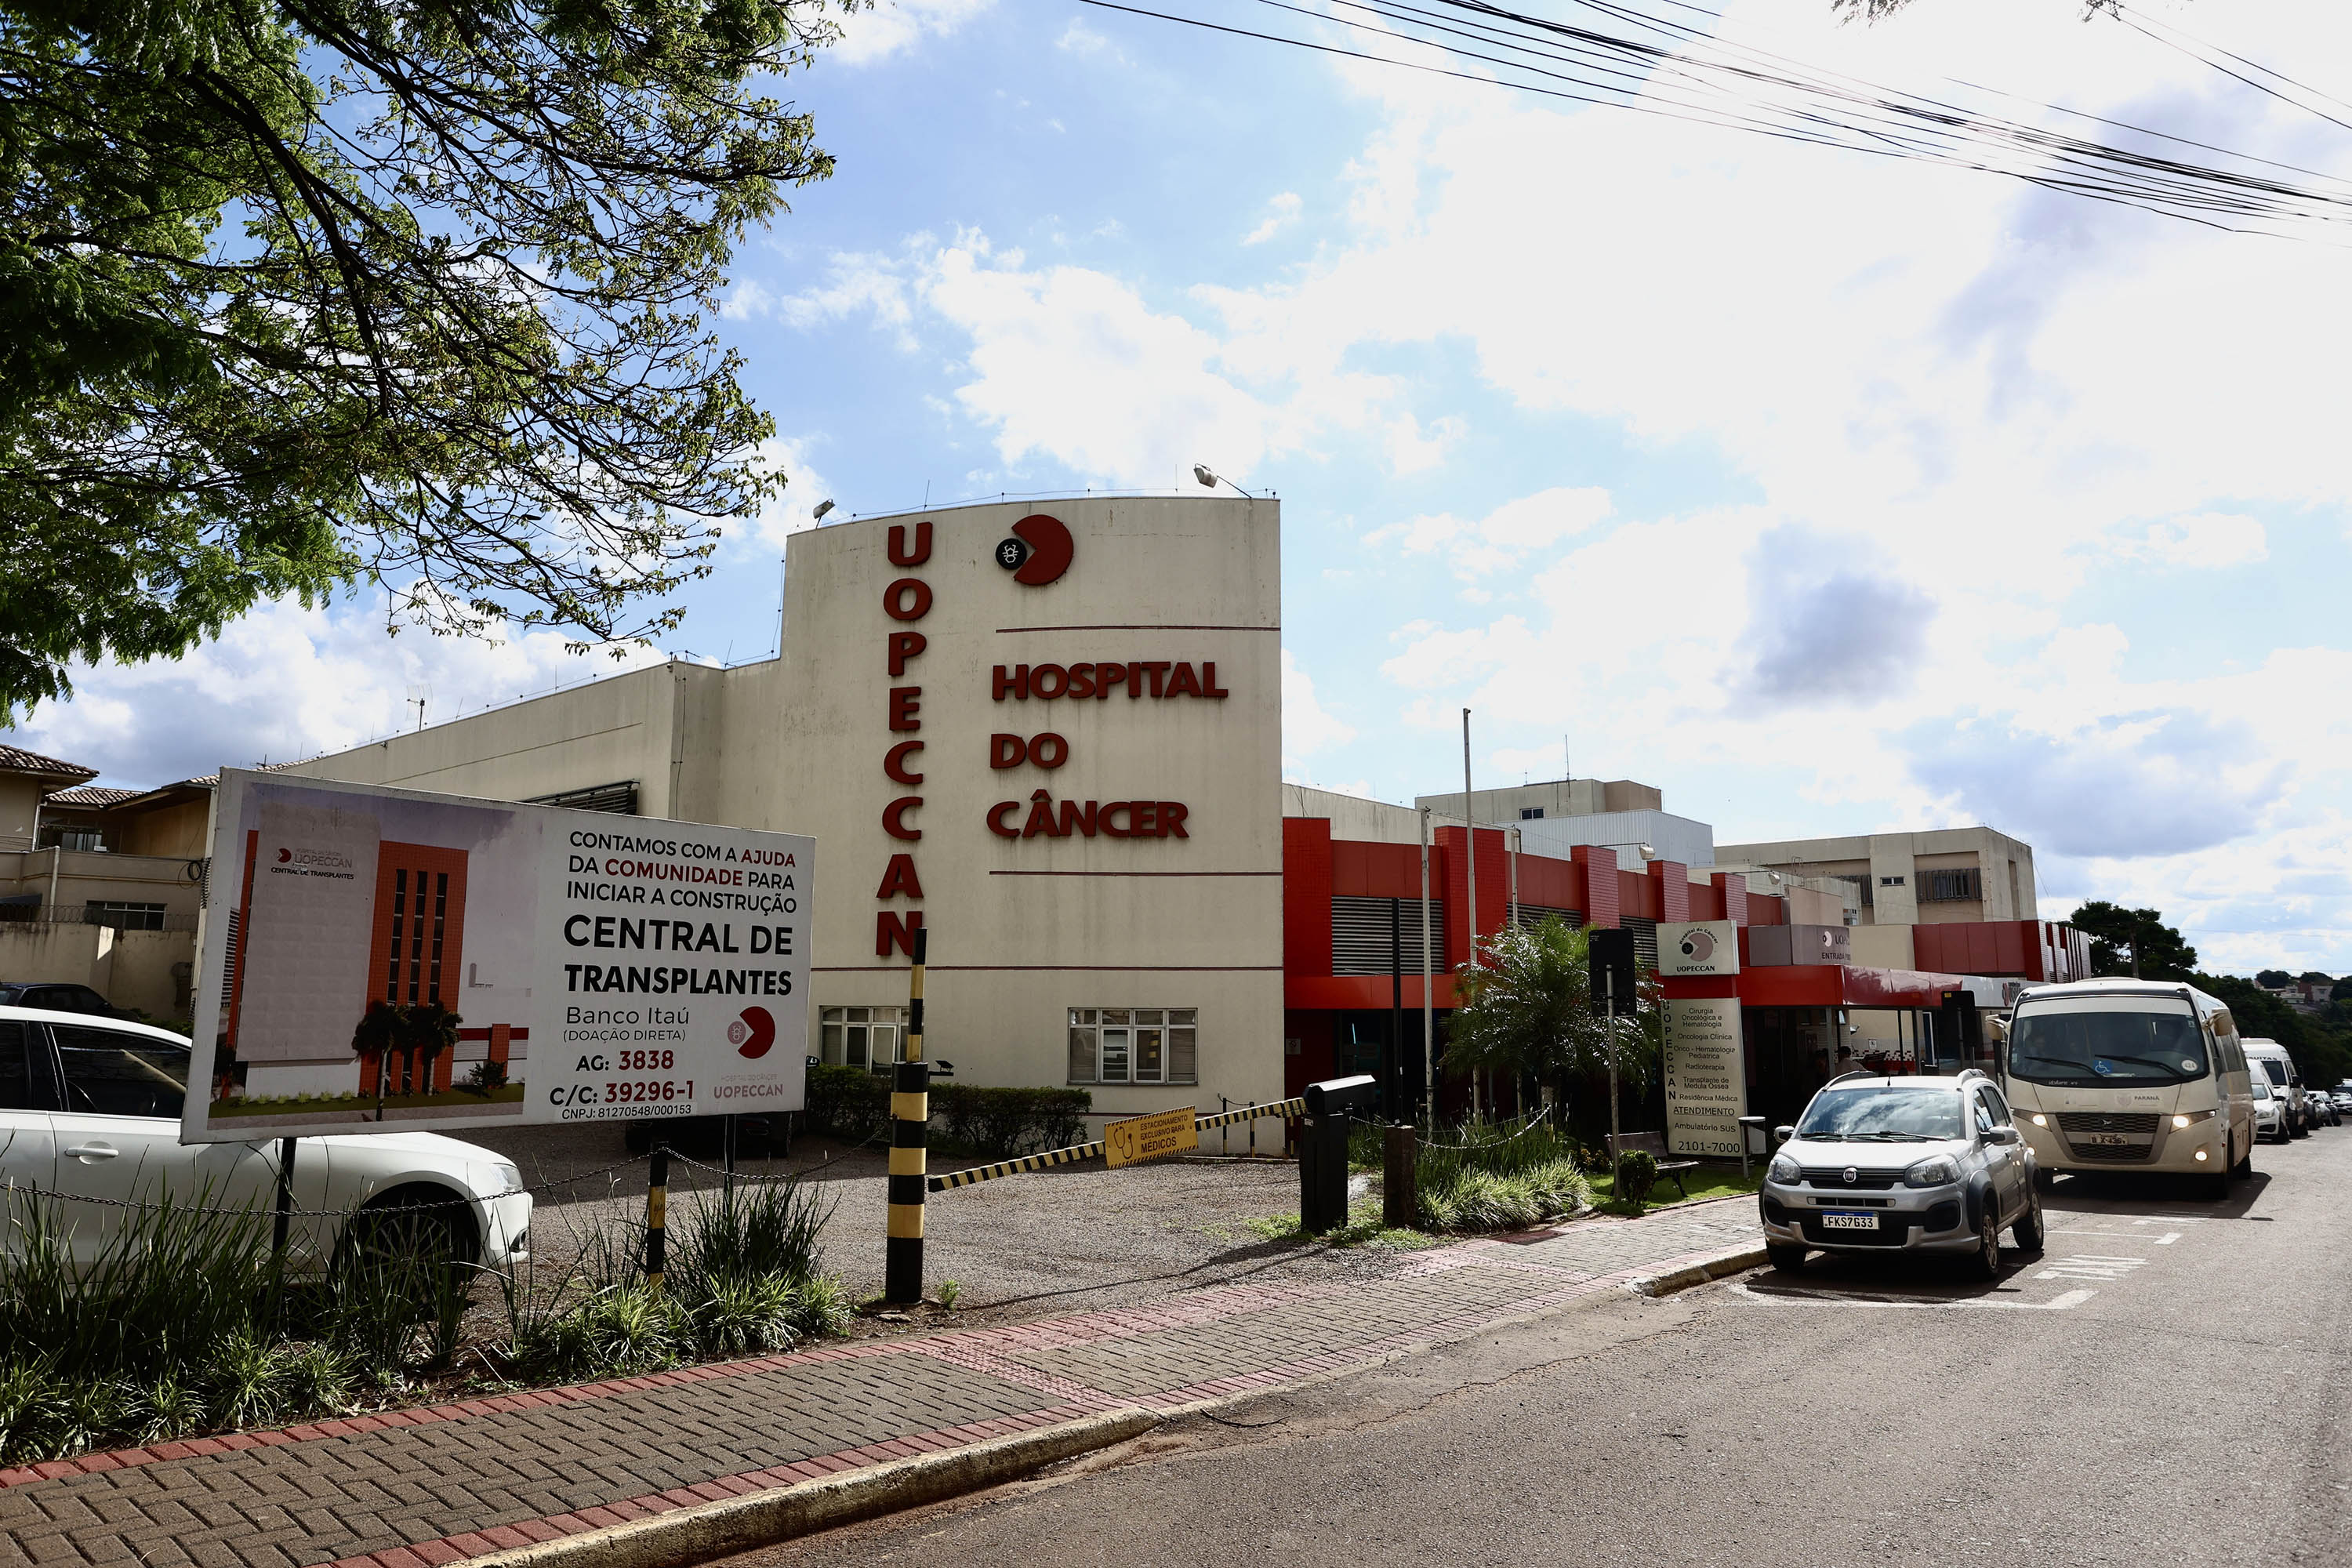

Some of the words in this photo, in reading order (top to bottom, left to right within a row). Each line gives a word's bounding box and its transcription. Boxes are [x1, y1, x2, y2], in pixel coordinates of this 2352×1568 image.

[991, 661, 1229, 701] HOSPITAL
[875, 521, 933, 957] UOPECCAN
[989, 732, 1069, 769] DO
[986, 789, 1189, 839] CÂNCER
[569, 831, 677, 856] CONTAMOS
[681, 842, 720, 861] COM
[724, 847, 737, 862] A
[740, 848, 796, 867] AJUDA
[295, 853, 353, 868] UOPECCAN
[270, 866, 299, 875] CENTRAL
[310, 870, 354, 880] TRANSPLANTES
[568, 855, 599, 874] DA
[605, 858, 743, 887] COMUNIDADE
[747, 871, 795, 891] PARA
[567, 880, 645, 903] INICIAR
[650, 888, 666, 905] A
[670, 889, 797, 916] CONSTRUÇÃO
[564, 914, 739, 953] CENTRAL
[750, 924, 793, 956] DE
[1679, 927, 1696, 945] Hospital
[564, 964, 792, 996] TRANSPLANTES
[566, 1007, 640, 1025] Banco
[648, 1006, 689, 1025] Itaú
[563, 1029, 630, 1044] (DOAÇÃO
[634, 1029, 686, 1041] DIRETA)
[1662, 1000, 1676, 1100] UOPECCAN
[1695, 1045, 1736, 1054] Hematologia
[575, 1054, 610, 1072] AG:
[618, 1049, 675, 1070] 3838
[1685, 1063, 1726, 1072] Radioterapia
[550, 1084, 598, 1106] C/C:
[604, 1080, 694, 1103] 39296-1
[713, 1084, 783, 1099] UOPECCAN
[1679, 1093, 1714, 1102] Residência
[561, 1108, 596, 1120] CNPJ:
[597, 1104, 691, 1119] 81270548/000153
[1673, 1106, 1735, 1116] ATENDIMENTO
[1140, 1114, 1188, 1131] ESTACIONAMENTO
[1674, 1122, 1718, 1131] Ambulatório
[1141, 1128, 1171, 1141] EXCLUSIVO
[1141, 1136, 1177, 1153] MÉDICOS
[1679, 1141, 1740, 1152] 2101-7000
[1828, 1216, 1873, 1228] FKS7G33
[2032, 1254, 2150, 1280] TAXI
